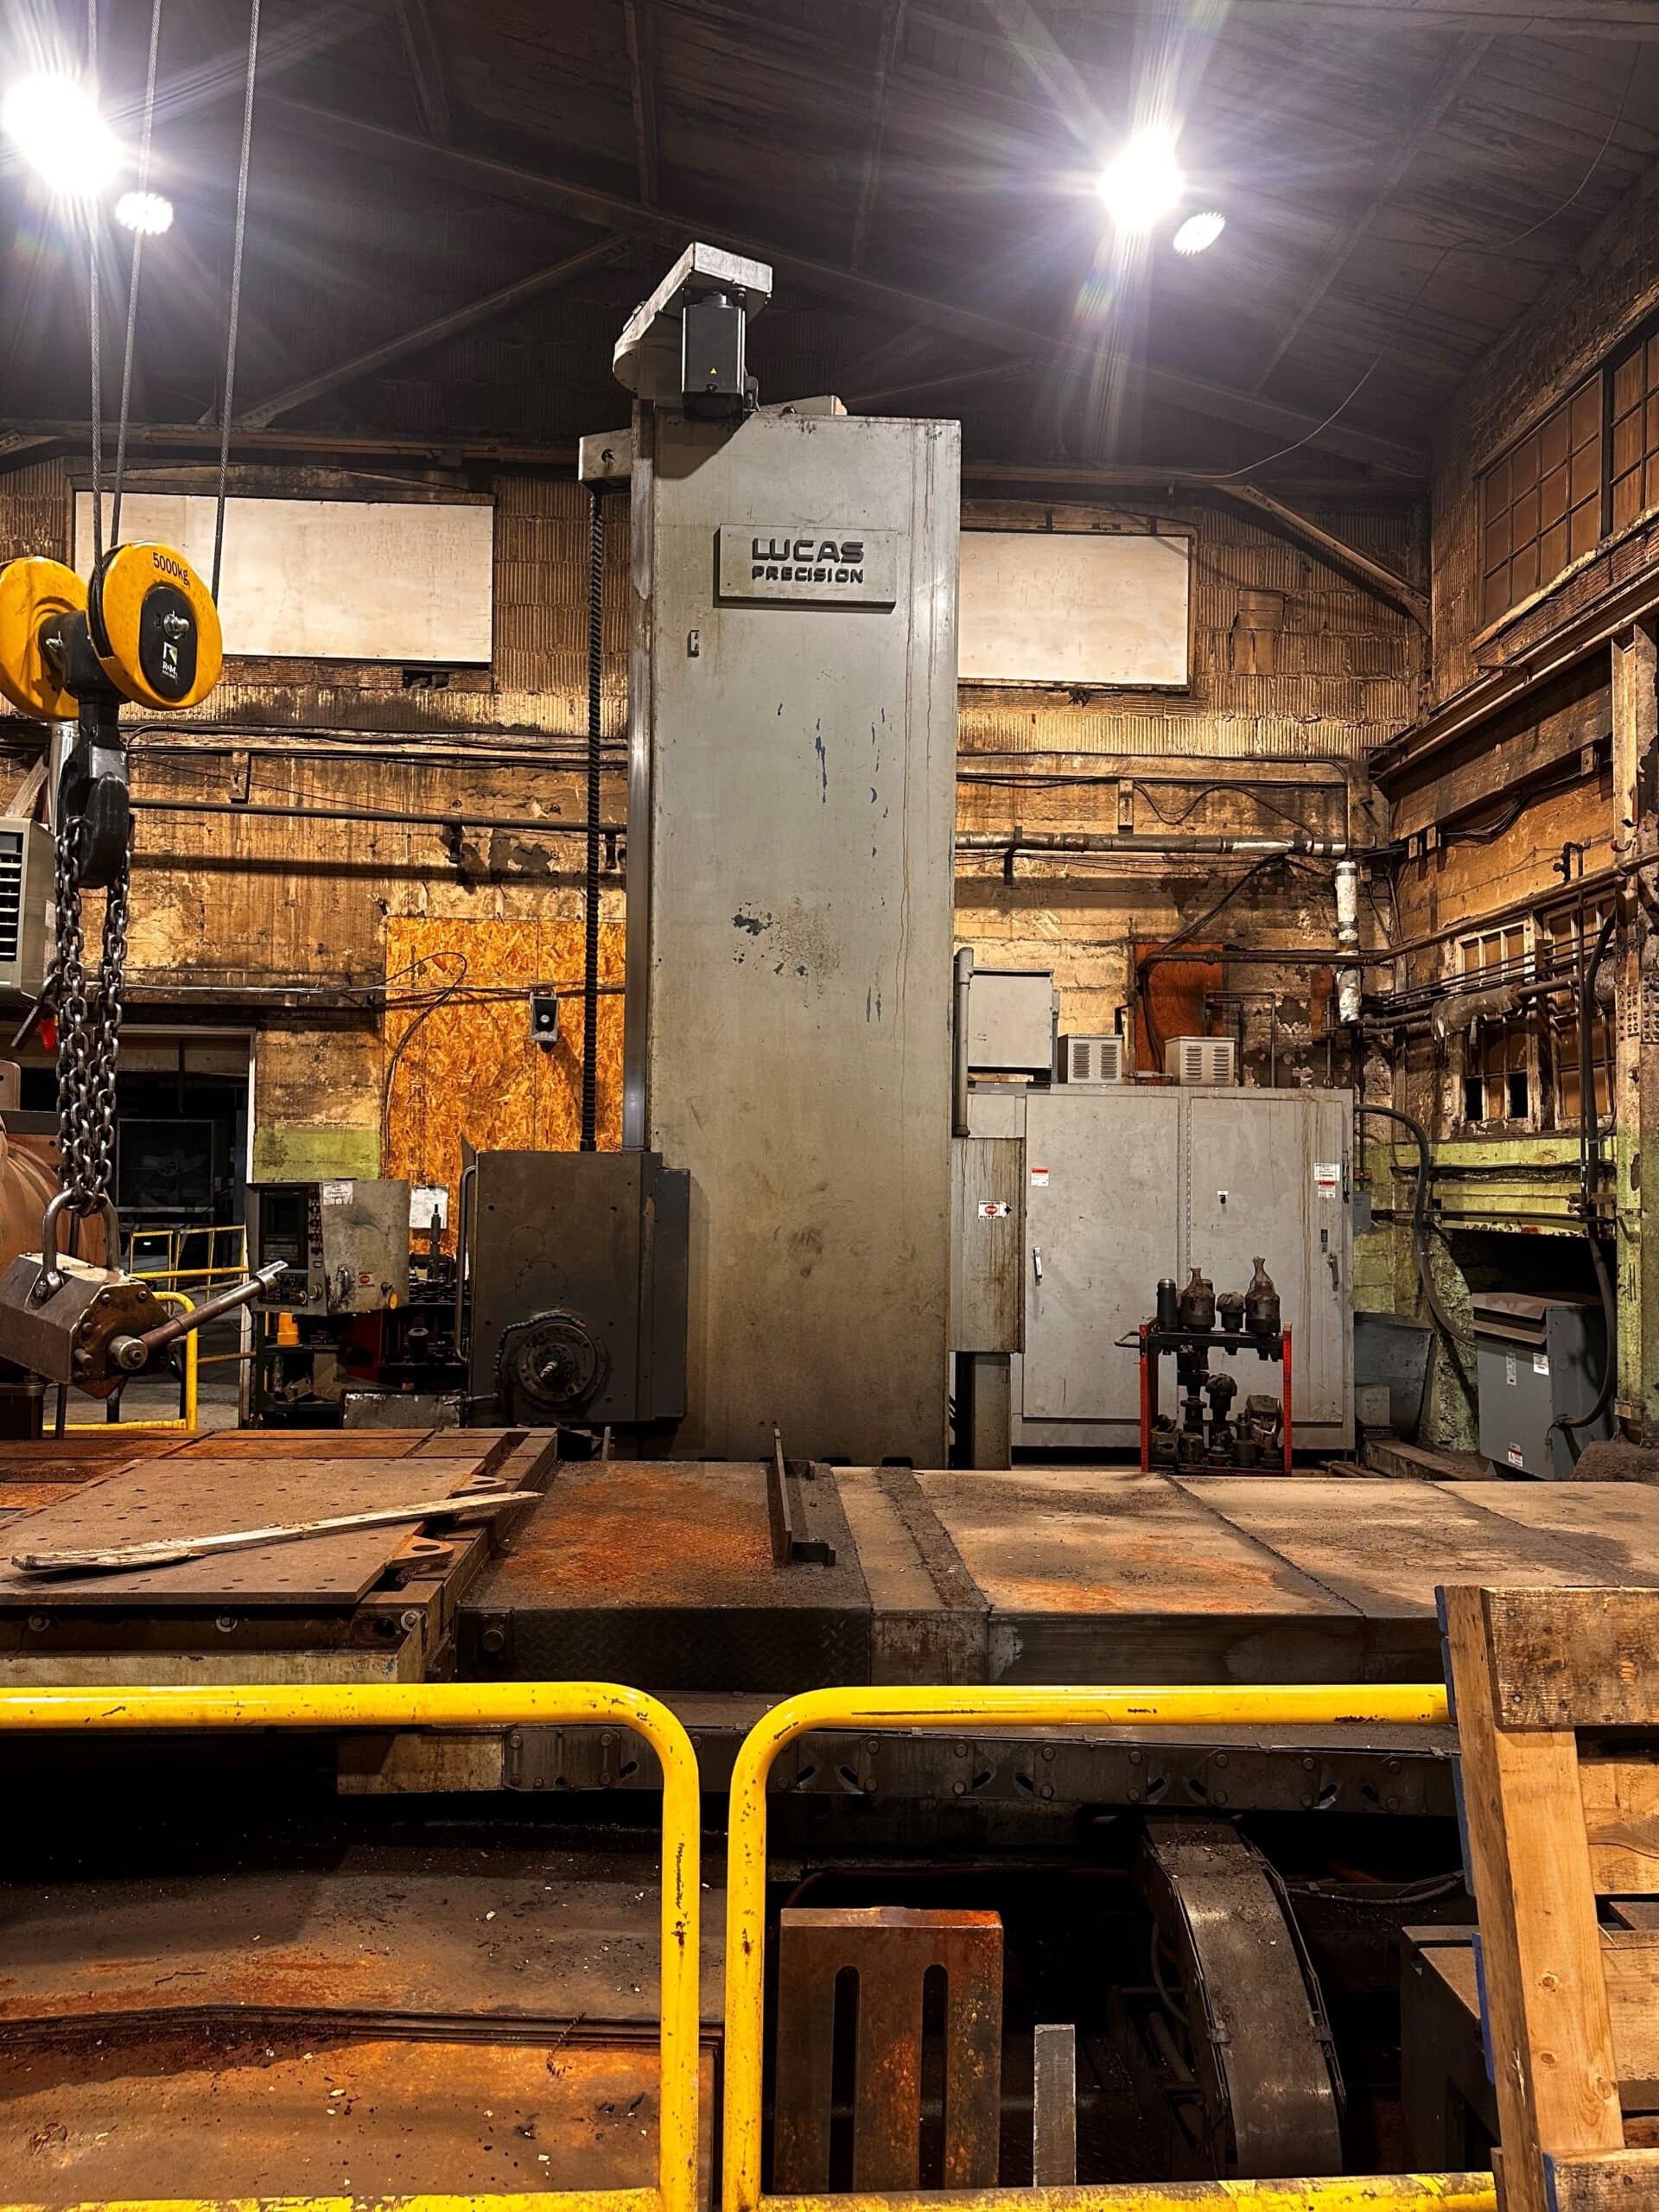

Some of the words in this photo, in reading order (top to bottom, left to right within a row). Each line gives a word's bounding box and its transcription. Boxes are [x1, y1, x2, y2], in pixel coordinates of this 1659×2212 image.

[752, 537, 864, 563] LUCAS
[153, 552, 189, 586] 5000kg
[752, 565, 864, 584] PRECISION
